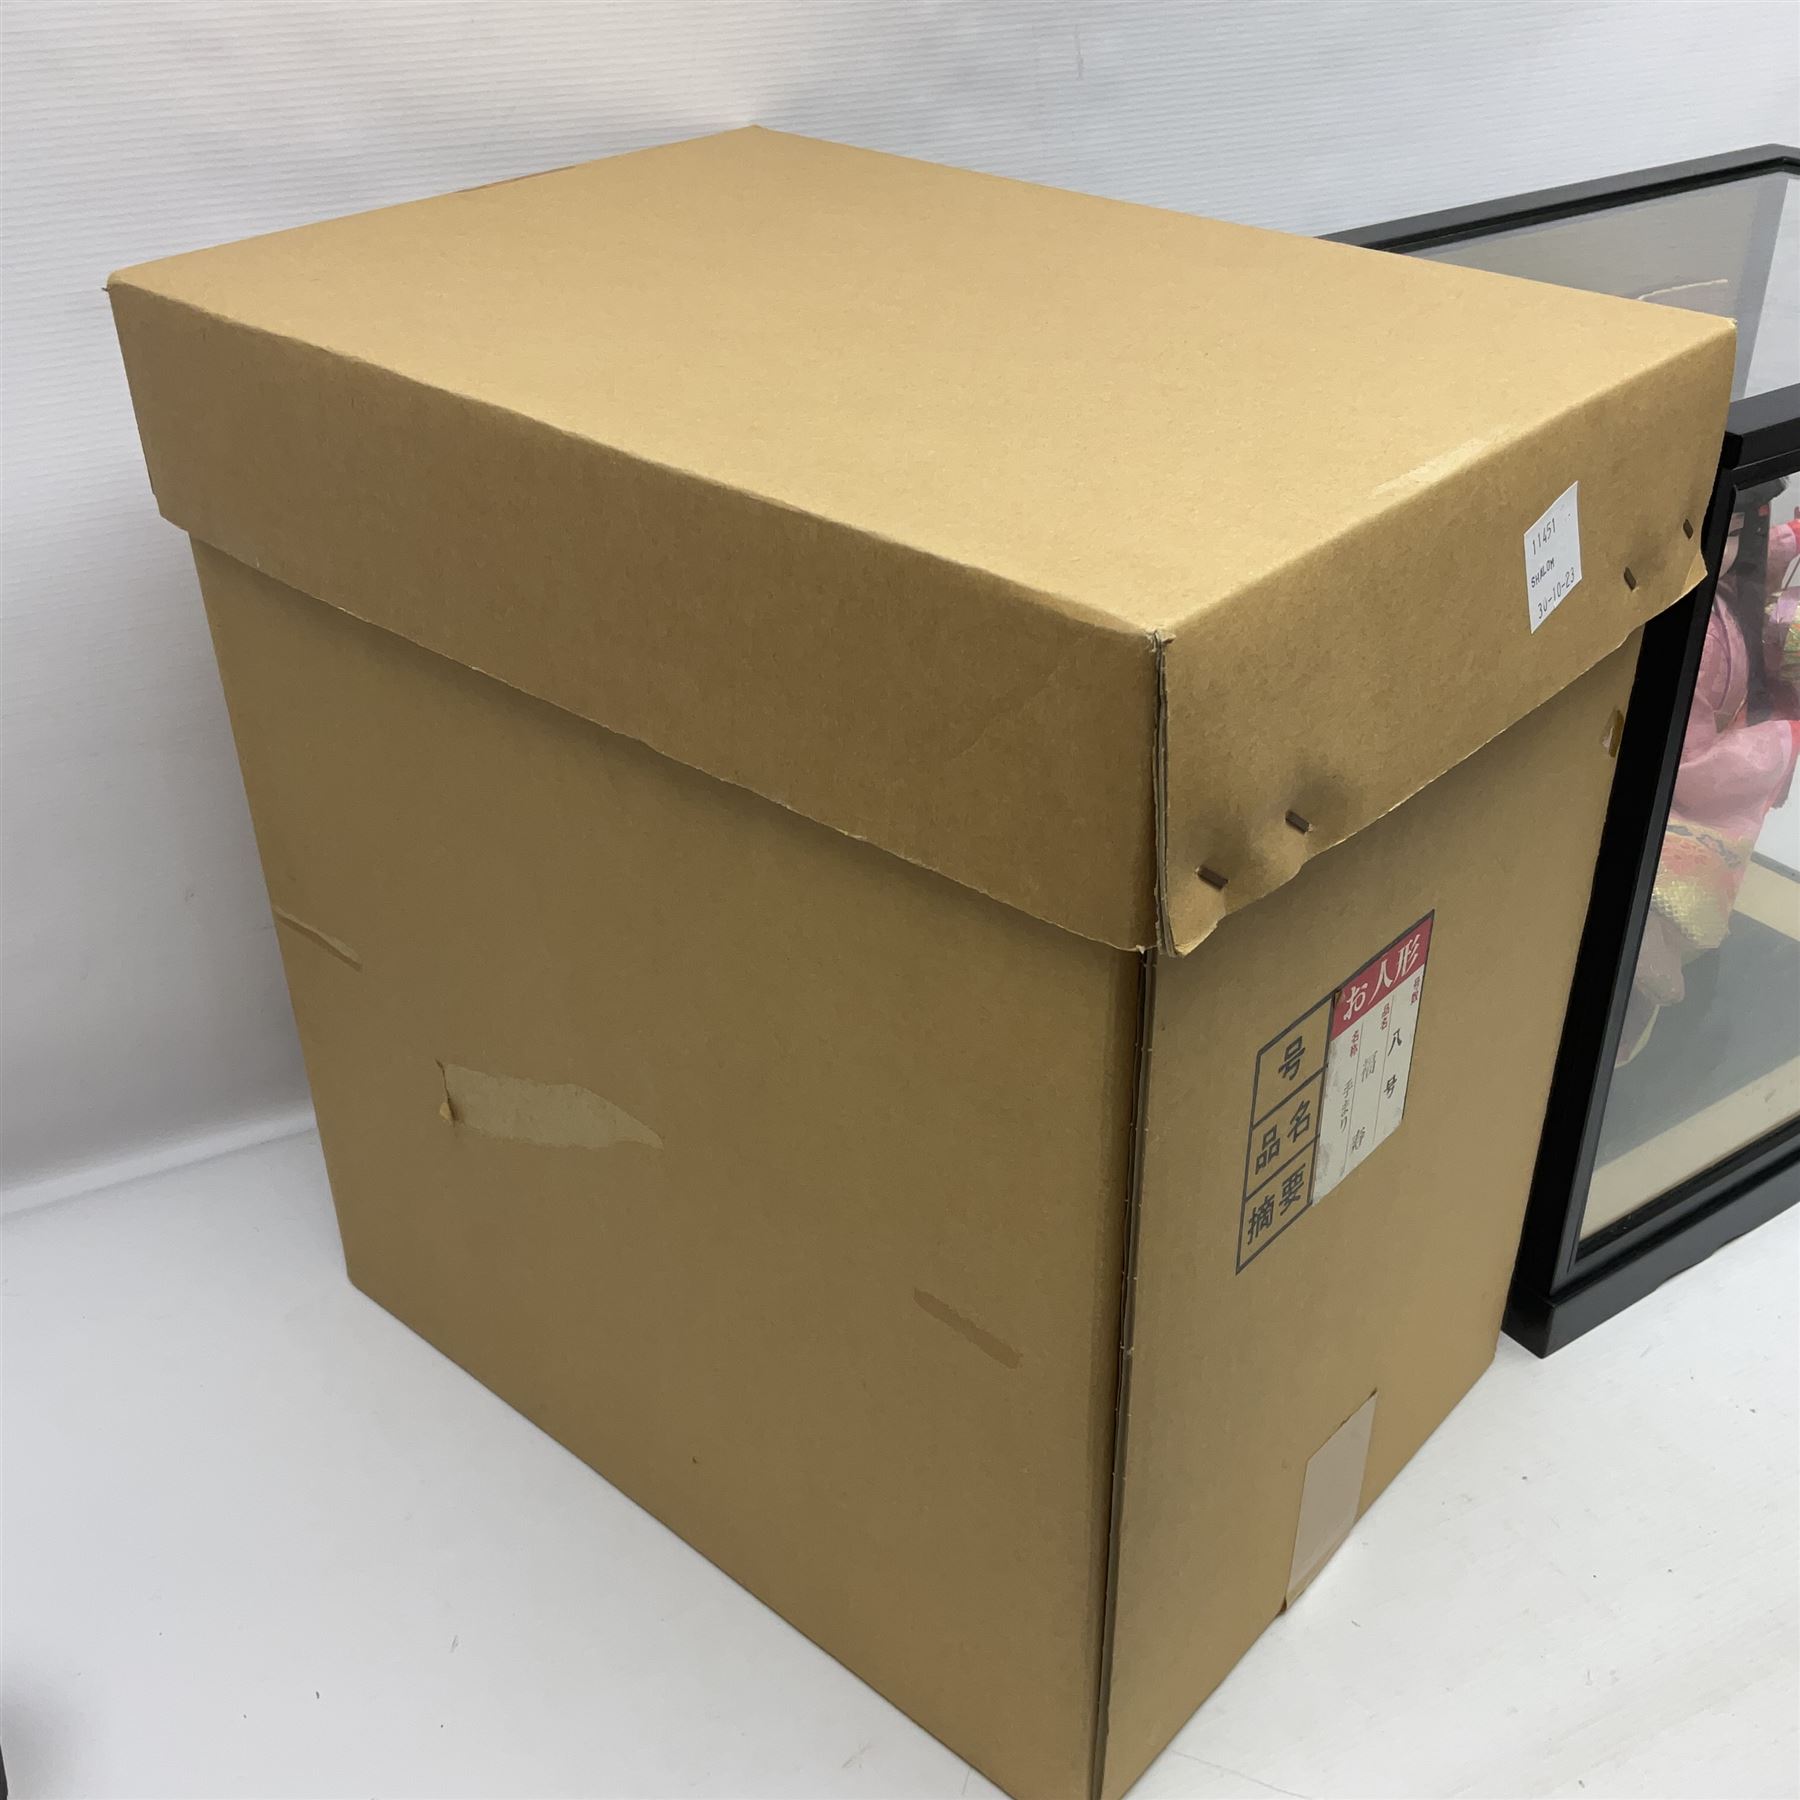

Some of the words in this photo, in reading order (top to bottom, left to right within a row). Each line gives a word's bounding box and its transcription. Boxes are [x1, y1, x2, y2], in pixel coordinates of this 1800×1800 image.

[1531, 517, 1557, 555] 11451
[1530, 557, 1556, 589] SHALOM
[1343, 933, 1421, 1021] お人形
[1379, 1002, 1390, 1031] 品名
[1278, 1036, 1307, 1081] 号
[1384, 1028, 1403, 1099] 八号
[1254, 1100, 1312, 1176] 品名
[1247, 1162, 1307, 1246] 摘要
